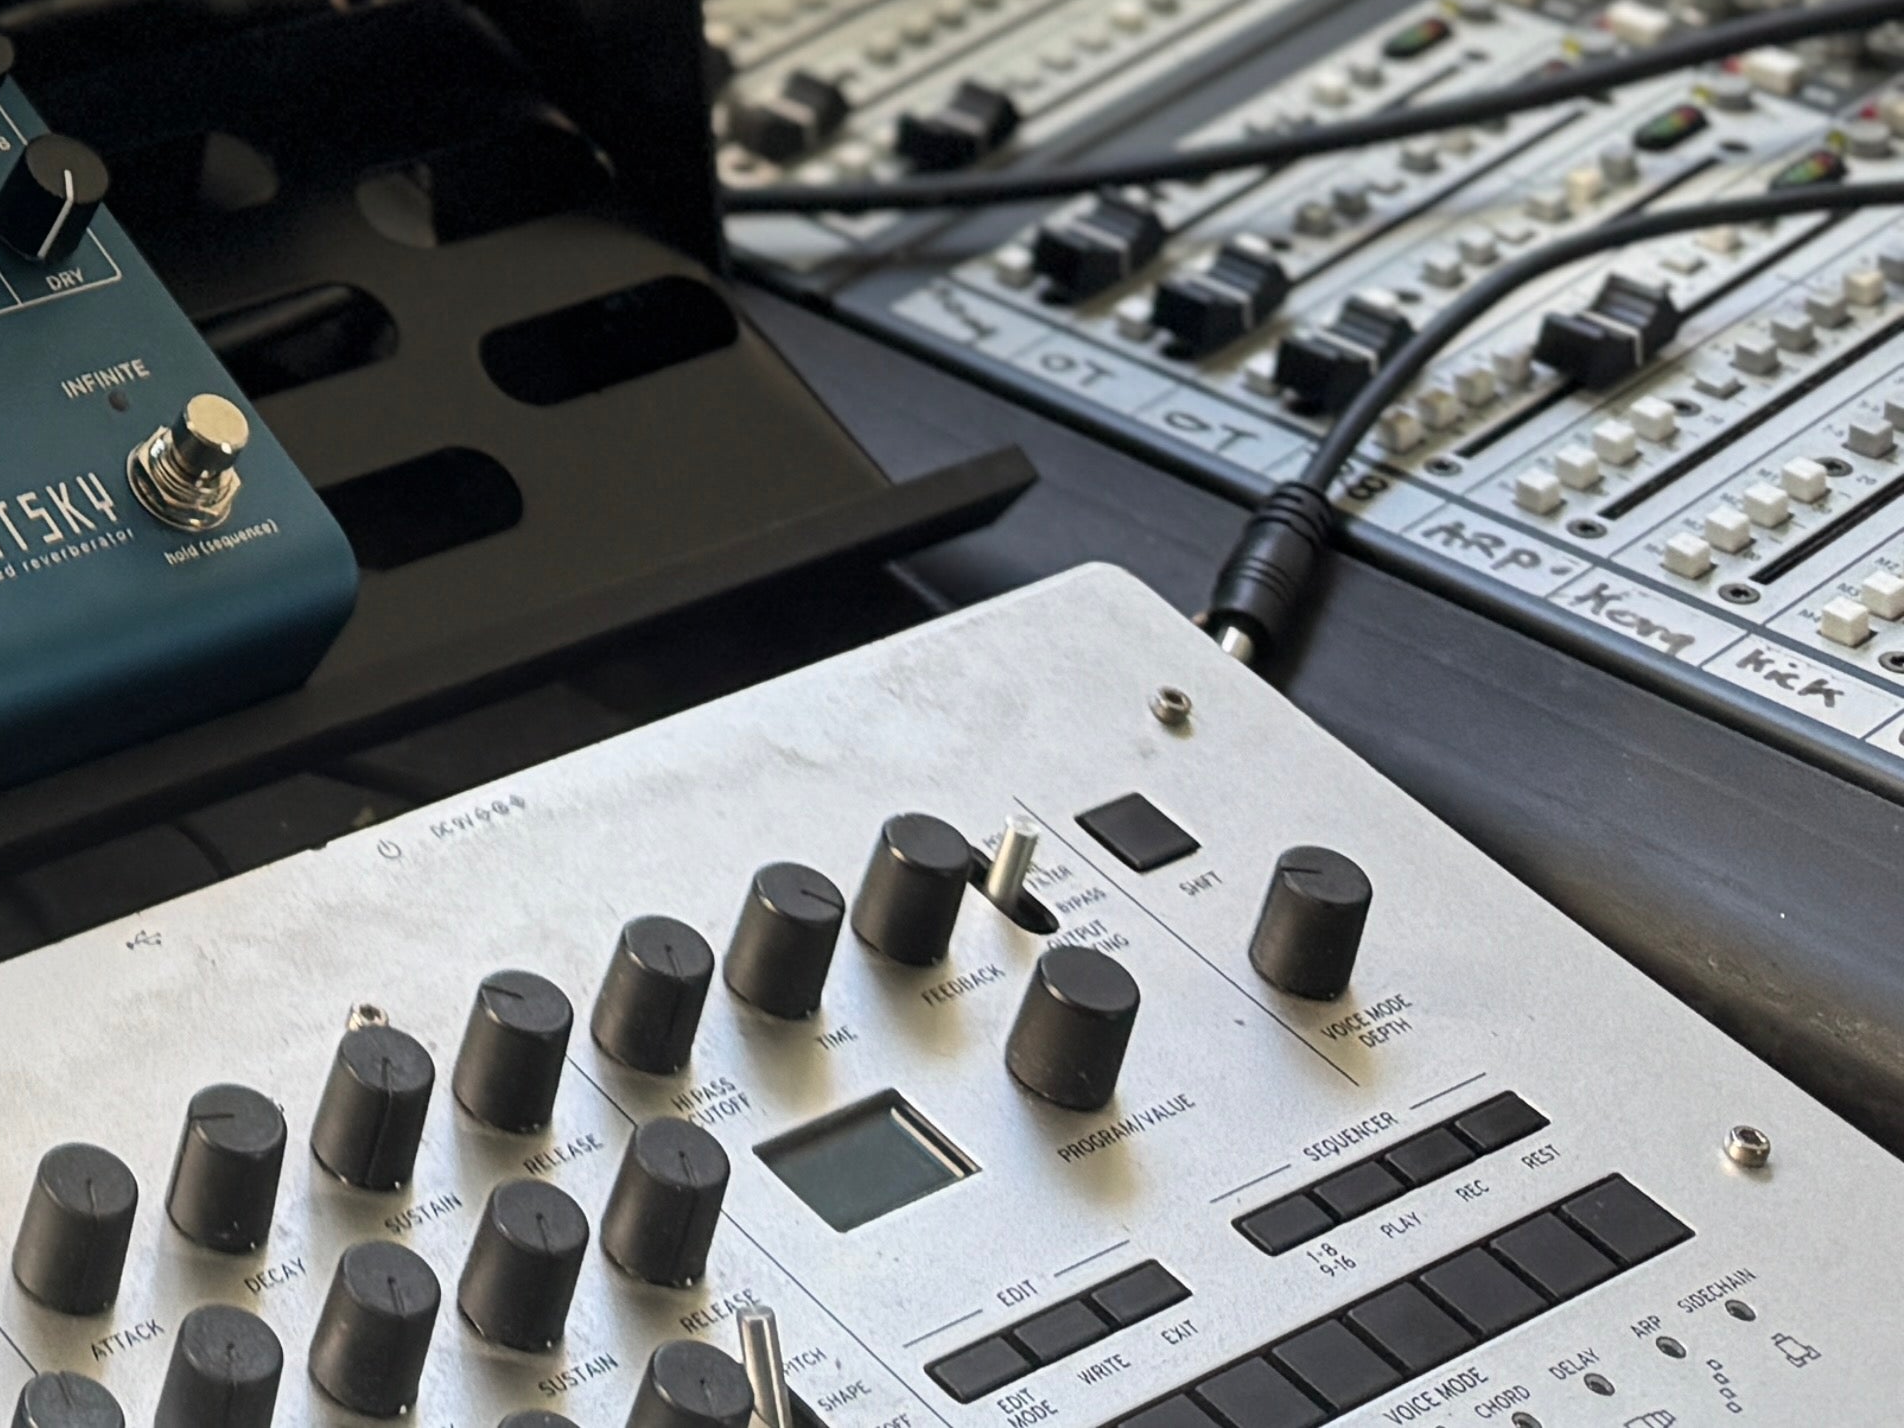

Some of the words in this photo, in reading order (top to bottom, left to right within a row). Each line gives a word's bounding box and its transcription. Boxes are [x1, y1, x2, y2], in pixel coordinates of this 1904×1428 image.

[45, 267, 86, 292] DRY
[60, 357, 152, 400] INFINITE
[21, 528, 135, 574] reverberator
[163, 542, 199, 567] hold
[201, 517, 280, 559] (sequence)
[1054, 886, 1107, 915] BYPASS
[920, 963, 1007, 1009] FEEDBACK
[1320, 1012, 1369, 1043] VOICE
[1365, 993, 1414, 1023] MODE
[1356, 1018, 1414, 1050] DEPTH
[816, 1028, 860, 1052] TIME
[1056, 1092, 1197, 1166] PROGRAM/VALUE
[1301, 1109, 1400, 1164] SEQUENCER
[522, 1136, 605, 1177] RELEASE
[1521, 1143, 1562, 1173] REST
[1454, 1177, 1491, 1205] REC
[383, 1192, 463, 1235] SUSTAIN
[1378, 1209, 1423, 1242] PLAY
[243, 1257, 308, 1296] DECAY
[1318, 1252, 1359, 1280] 9-16
[996, 1278, 1041, 1310] EDIT
[1675, 1266, 1759, 1316] SIDECHAIN
[679, 1287, 762, 1335] RELEASE
[1629, 1312, 1665, 1342] ARP
[91, 1318, 166, 1362] ATTACK
[1159, 1319, 1200, 1347] EXIT
[537, 1352, 620, 1401] SUSTAIN
[1077, 1352, 1133, 1388] WRITE
[1547, 1345, 1602, 1384] DELAY
[816, 1379, 873, 1413] SHAPE
[997, 1384, 1038, 1417] EDIT
[1007, 1399, 1059, 1428] MODE
[1382, 1388, 1440, 1428] VOICE
[1434, 1365, 1491, 1406] MODE
[1473, 1382, 1533, 1423] CHORD
